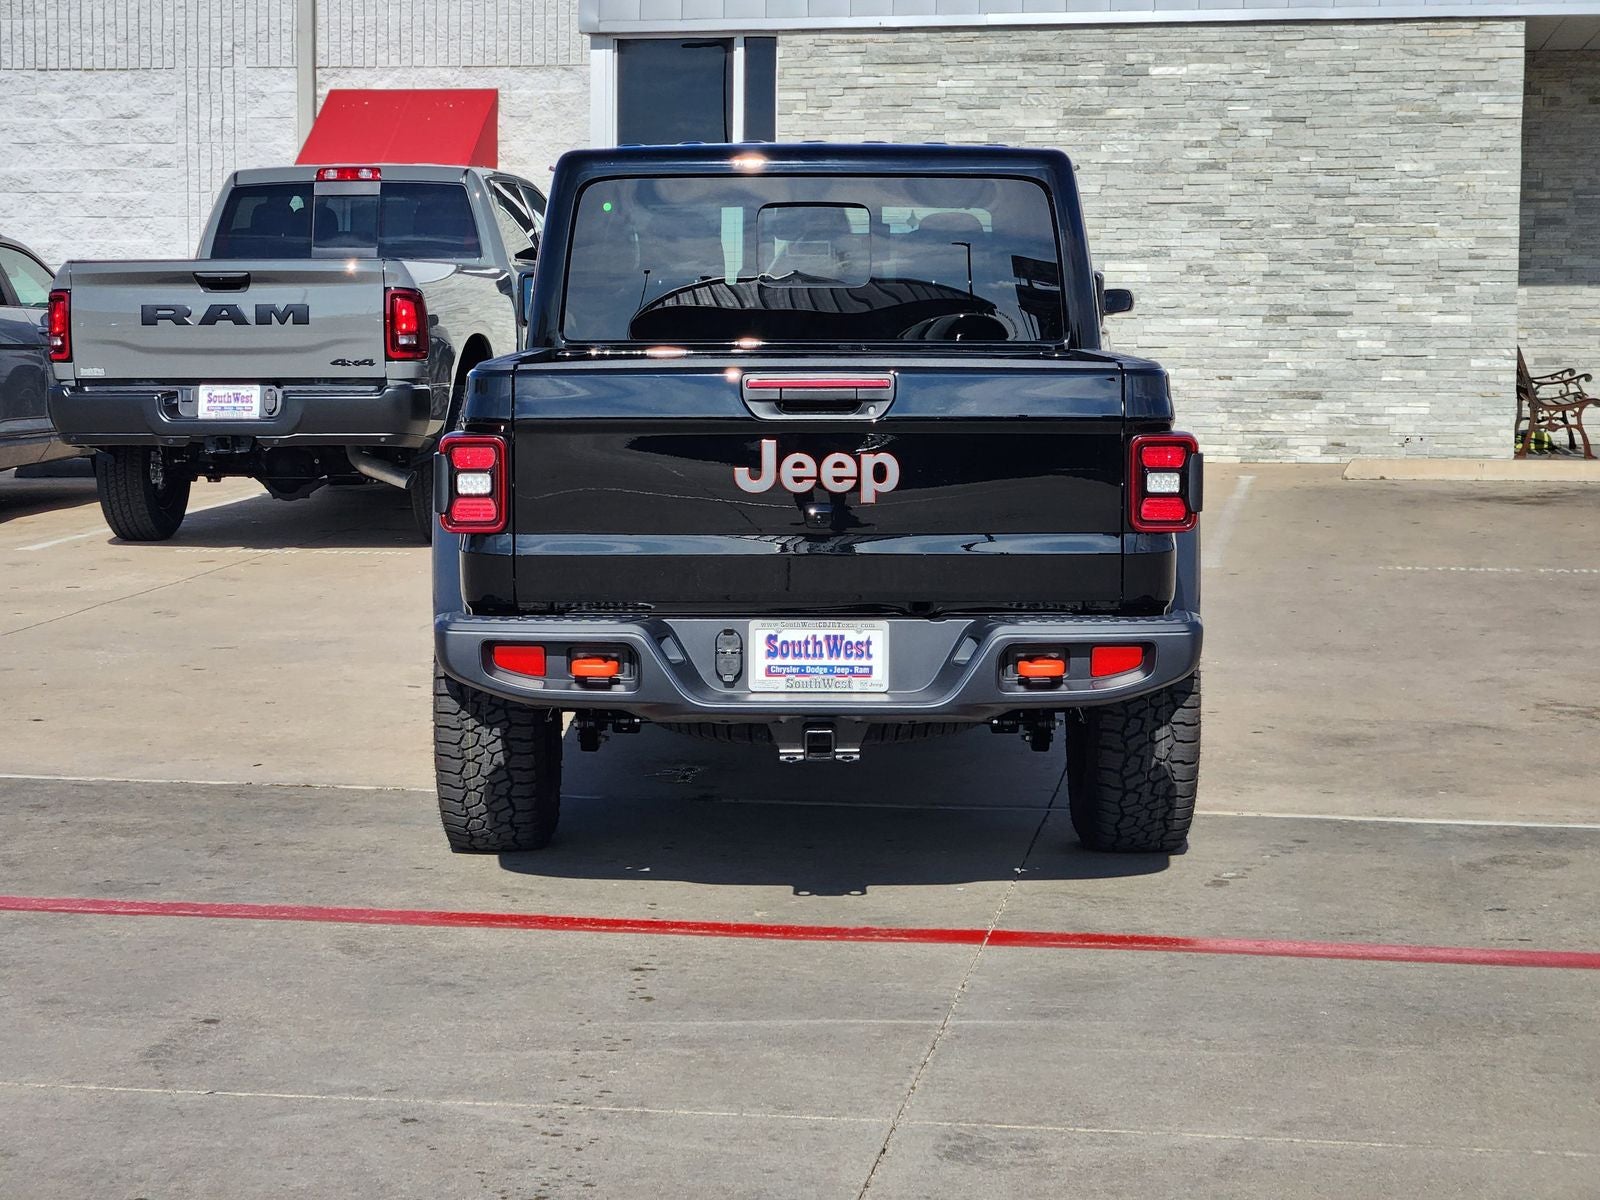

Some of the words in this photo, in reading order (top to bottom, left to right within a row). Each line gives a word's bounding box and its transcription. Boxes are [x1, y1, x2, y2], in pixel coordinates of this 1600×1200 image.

[141, 304, 309, 326] RAM
[330, 358, 376, 367] 4x4
[207, 392, 253, 404] SouthWest
[733, 438, 900, 505] Jeep
[765, 633, 873, 660] SouthWest
[770, 665, 800, 675] Chrysler
[805, 666, 828, 675] Dodge
[833, 666, 850, 675] Jeep
[854, 666, 870, 674] Ram
[785, 678, 853, 689] SouthWest
